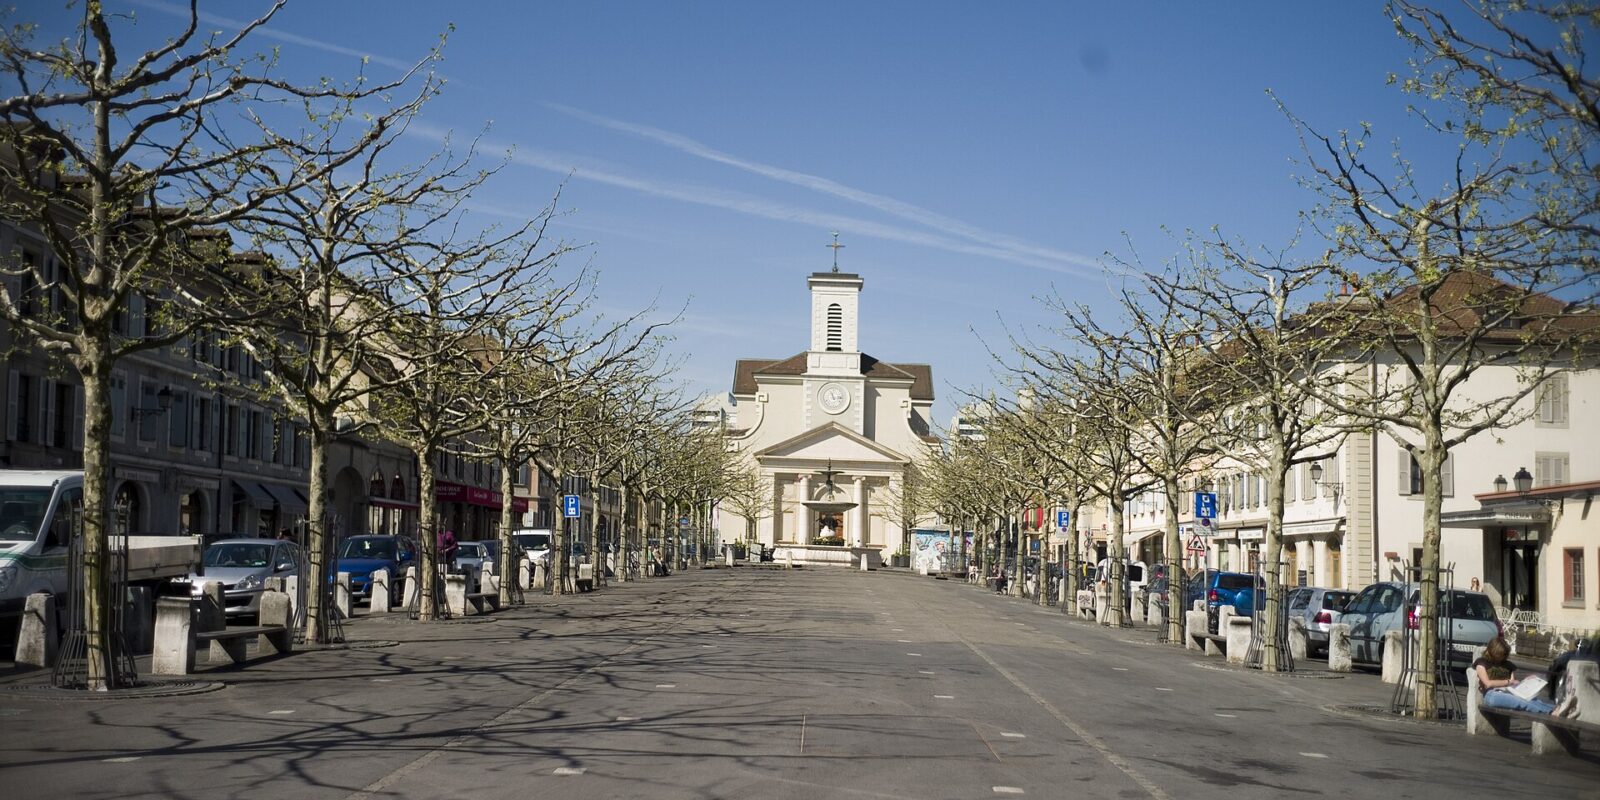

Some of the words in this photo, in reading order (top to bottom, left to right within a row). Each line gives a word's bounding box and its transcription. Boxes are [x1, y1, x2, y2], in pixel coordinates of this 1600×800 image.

[568, 497, 575, 507] P
[1202, 495, 1210, 507] P
[1061, 512, 1068, 521] P
